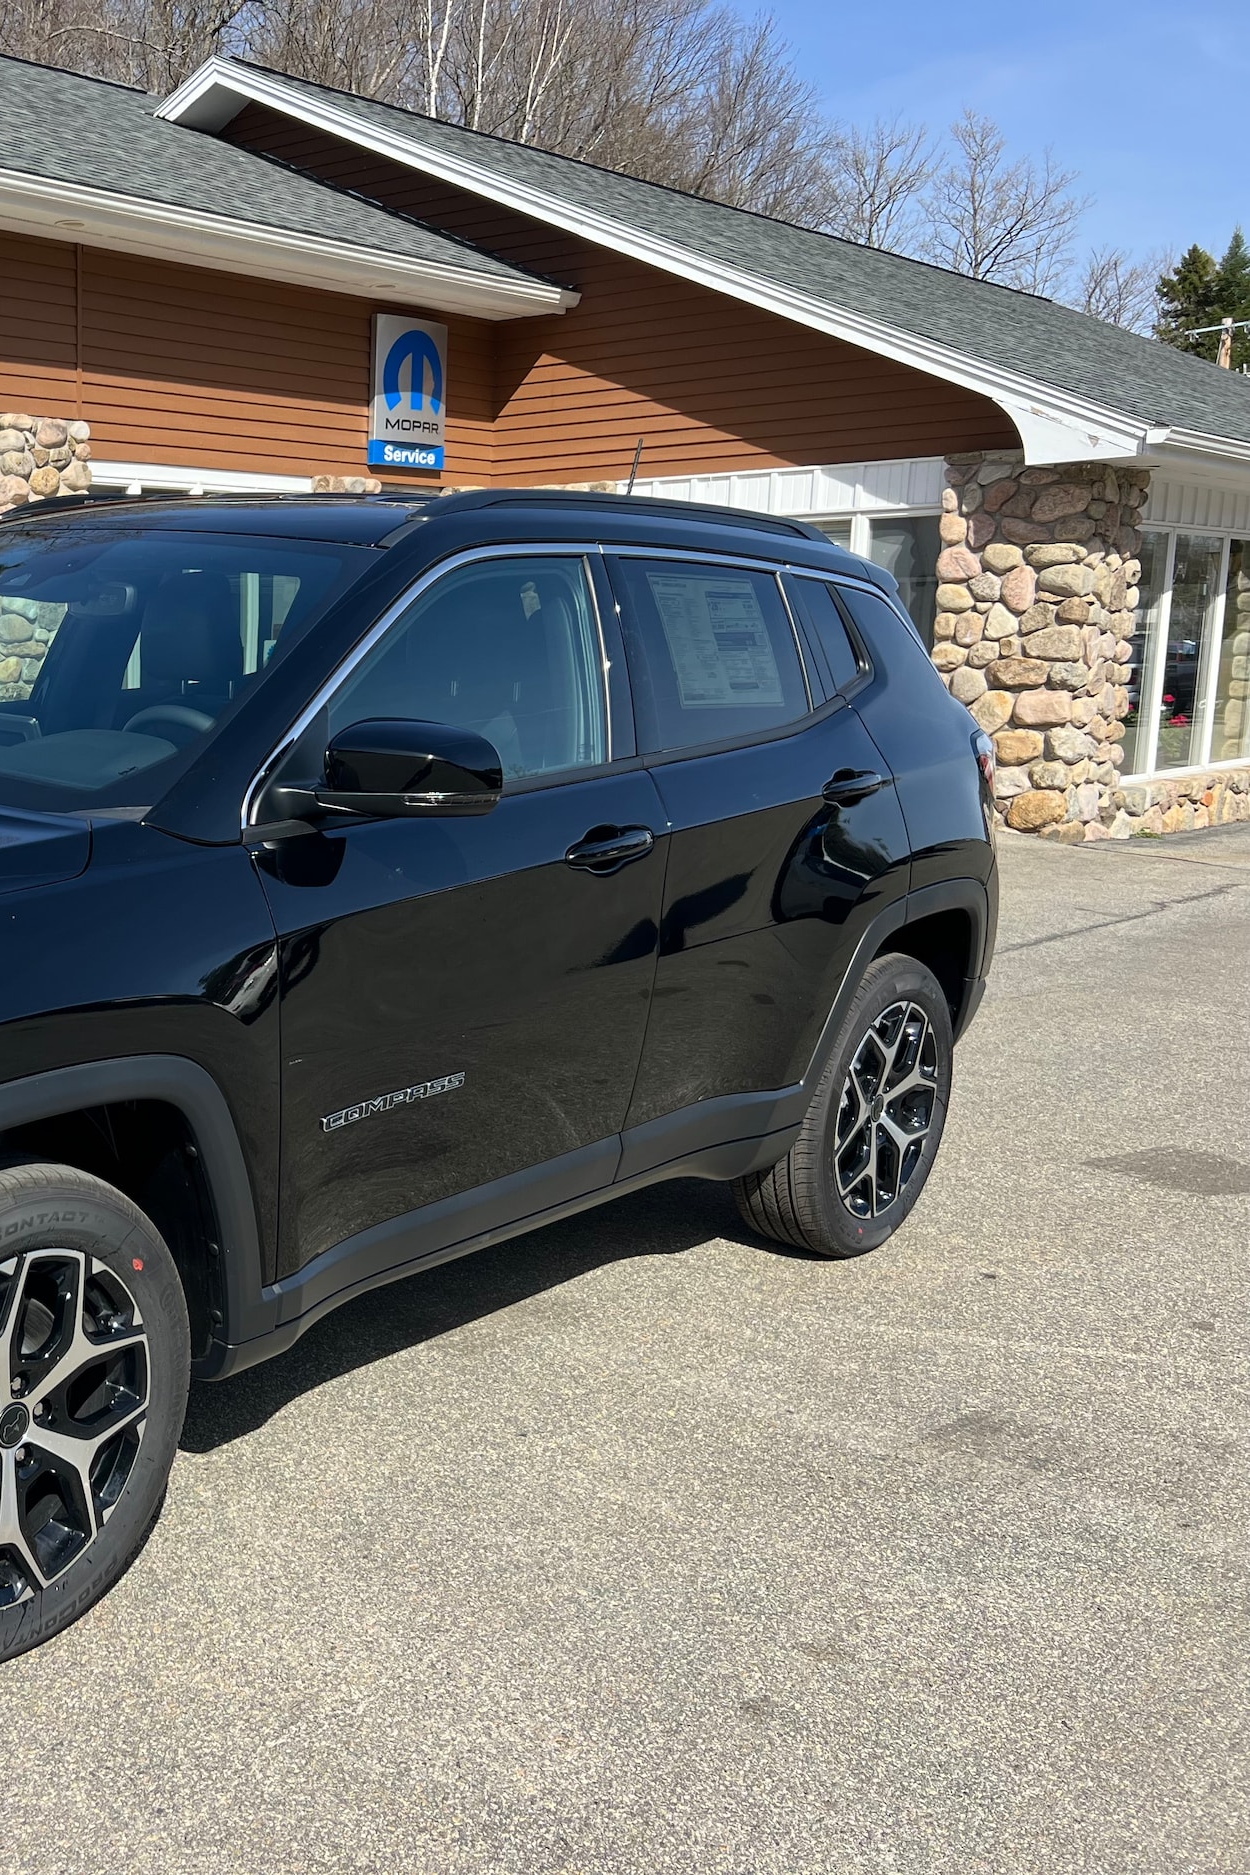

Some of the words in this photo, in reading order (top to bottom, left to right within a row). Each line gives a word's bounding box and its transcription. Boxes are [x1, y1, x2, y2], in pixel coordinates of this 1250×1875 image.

[385, 418, 439, 435] MOPAR
[384, 444, 436, 465] Service
[319, 1071, 466, 1132] COMPASS
